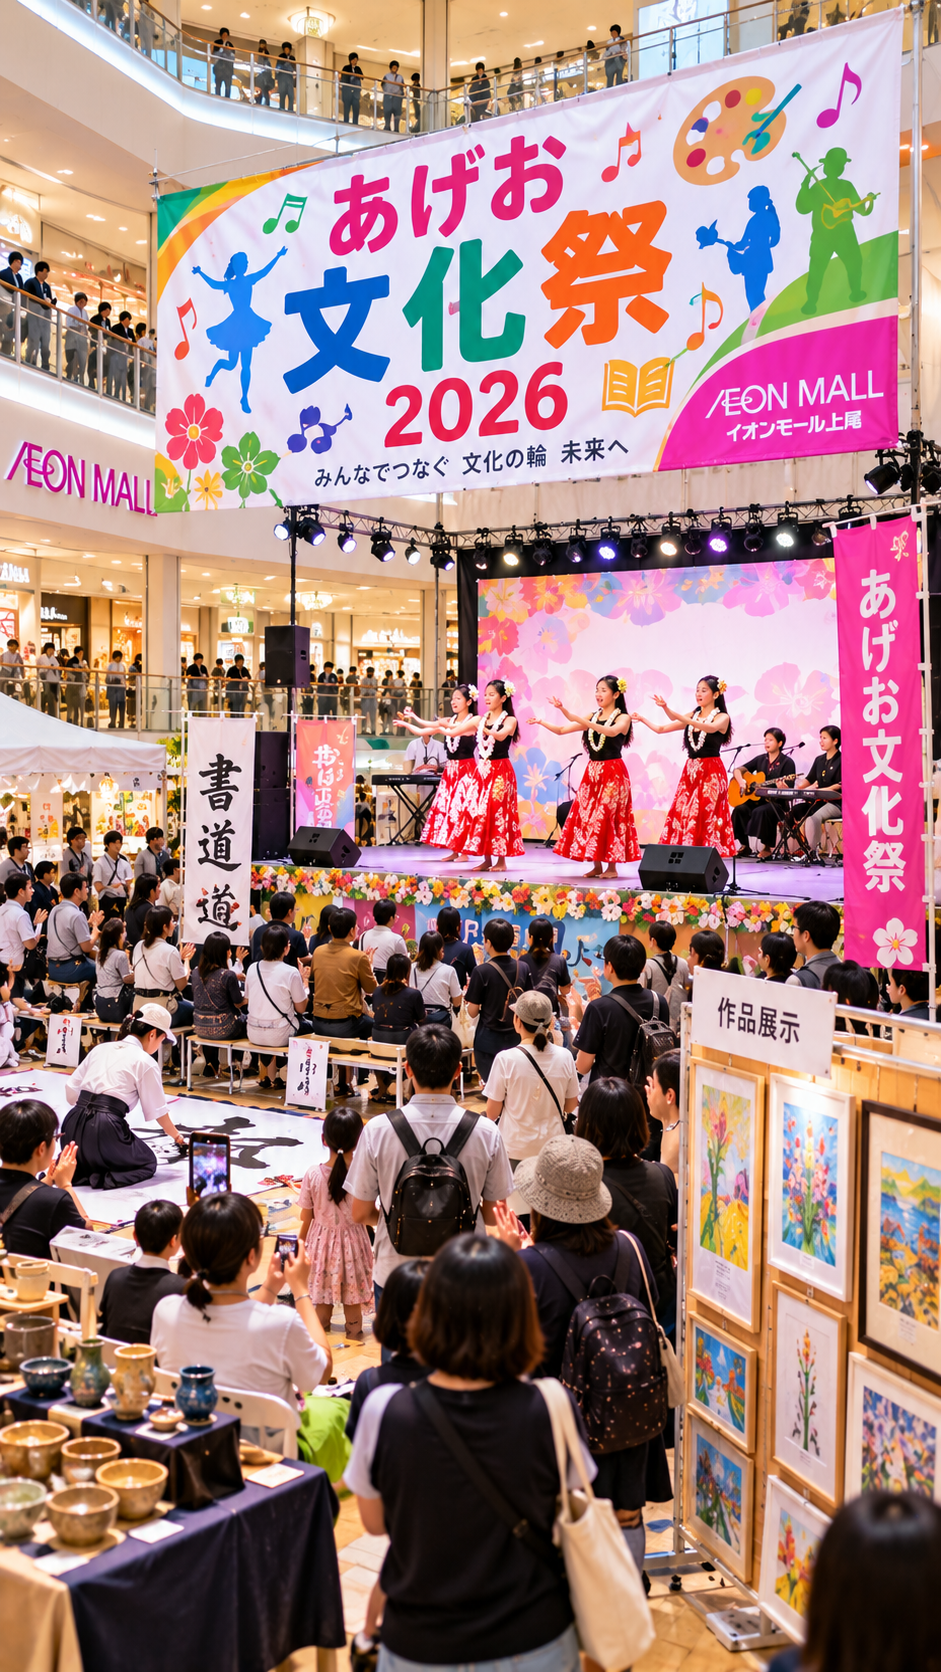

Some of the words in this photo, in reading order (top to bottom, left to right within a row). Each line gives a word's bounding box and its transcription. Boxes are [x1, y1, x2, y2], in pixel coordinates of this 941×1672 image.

[329, 135, 567, 256] あげお
[282, 200, 673, 395] 文化祭
[384, 361, 569, 448] 2026
[798, 370, 884, 407] MALL
[726, 410, 862, 442] イオンモール上尾
[314, 456, 450, 488] みんなでつなぐ
[462, 444, 547, 475] 文化の輪
[561, 437, 629, 464] 未来へ
[91, 463, 158, 517] MALL
[859, 568, 907, 893] あげお文化祭
[717, 996, 800, 1044] 作品展示
